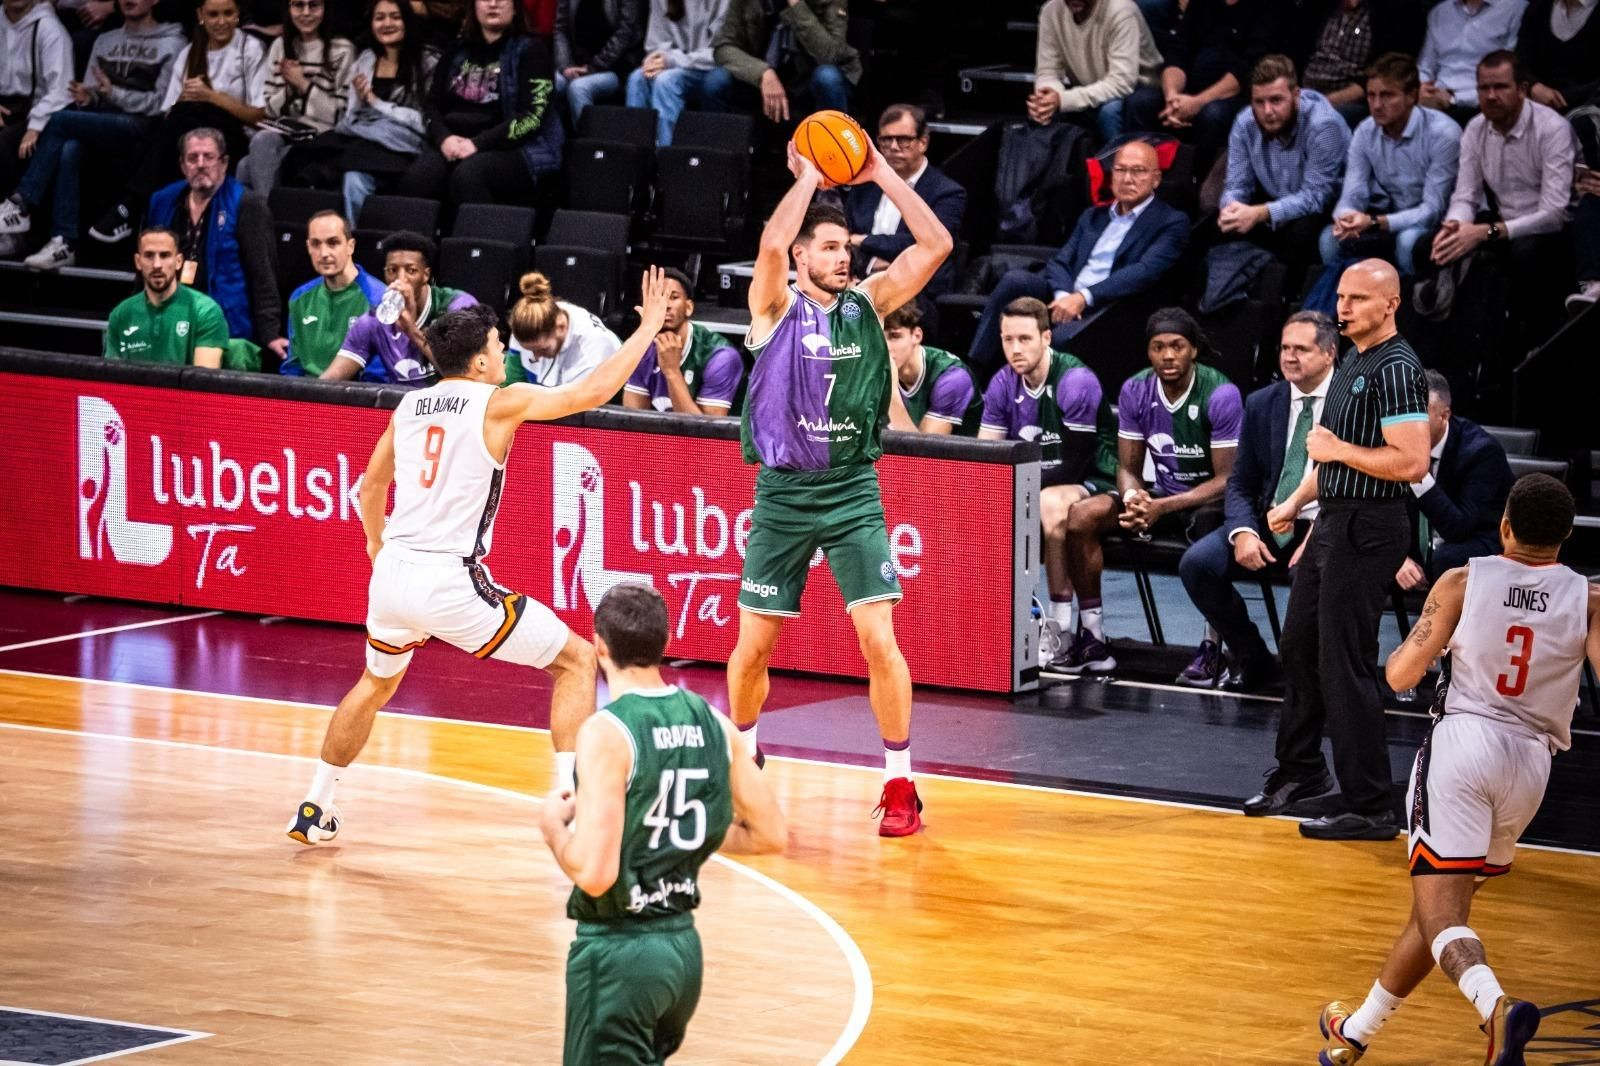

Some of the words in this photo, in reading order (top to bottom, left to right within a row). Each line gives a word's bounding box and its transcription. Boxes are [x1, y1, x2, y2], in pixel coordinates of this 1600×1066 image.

[961, 78, 973, 93] D
[720, 274, 731, 289] B
[829, 342, 861, 356] Unicaja
[823, 373, 837, 407] 7
[415, 396, 470, 416] DELAUNAY
[797, 414, 857, 432] Andalucía
[420, 425, 446, 489] 9
[1172, 443, 1204, 456] Unicaja
[150, 434, 366, 521] lubelsk
[186, 522, 256, 590] Ta
[667, 571, 743, 640] Ta
[1503, 586, 1550, 613] JONES
[1496, 624, 1535, 698] 3
[642, 768, 710, 850] 45
